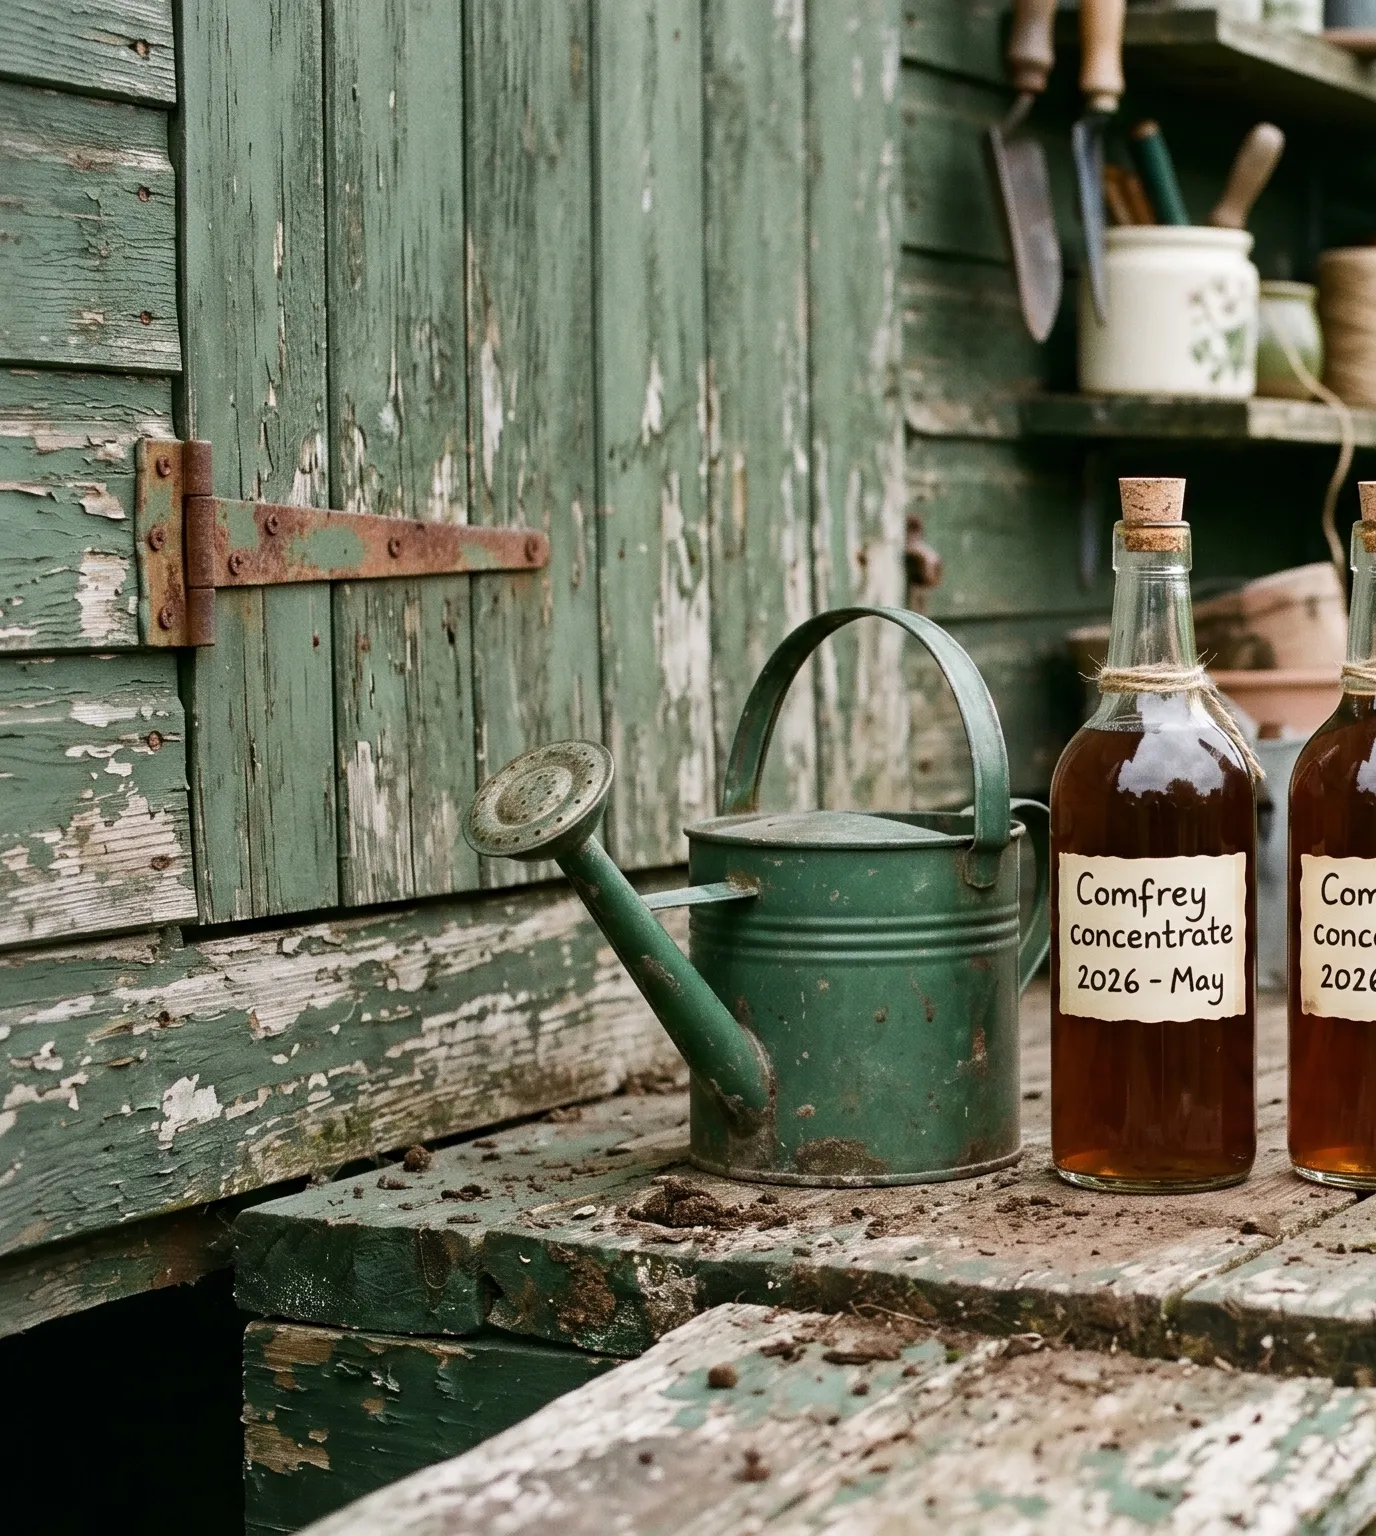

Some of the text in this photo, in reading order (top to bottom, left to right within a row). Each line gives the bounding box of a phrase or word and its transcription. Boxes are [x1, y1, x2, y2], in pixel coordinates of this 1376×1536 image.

[1076, 871, 1206, 923] Comfrey
[1077, 964, 1140, 994] 2026
[1170, 965, 1224, 1006] May
